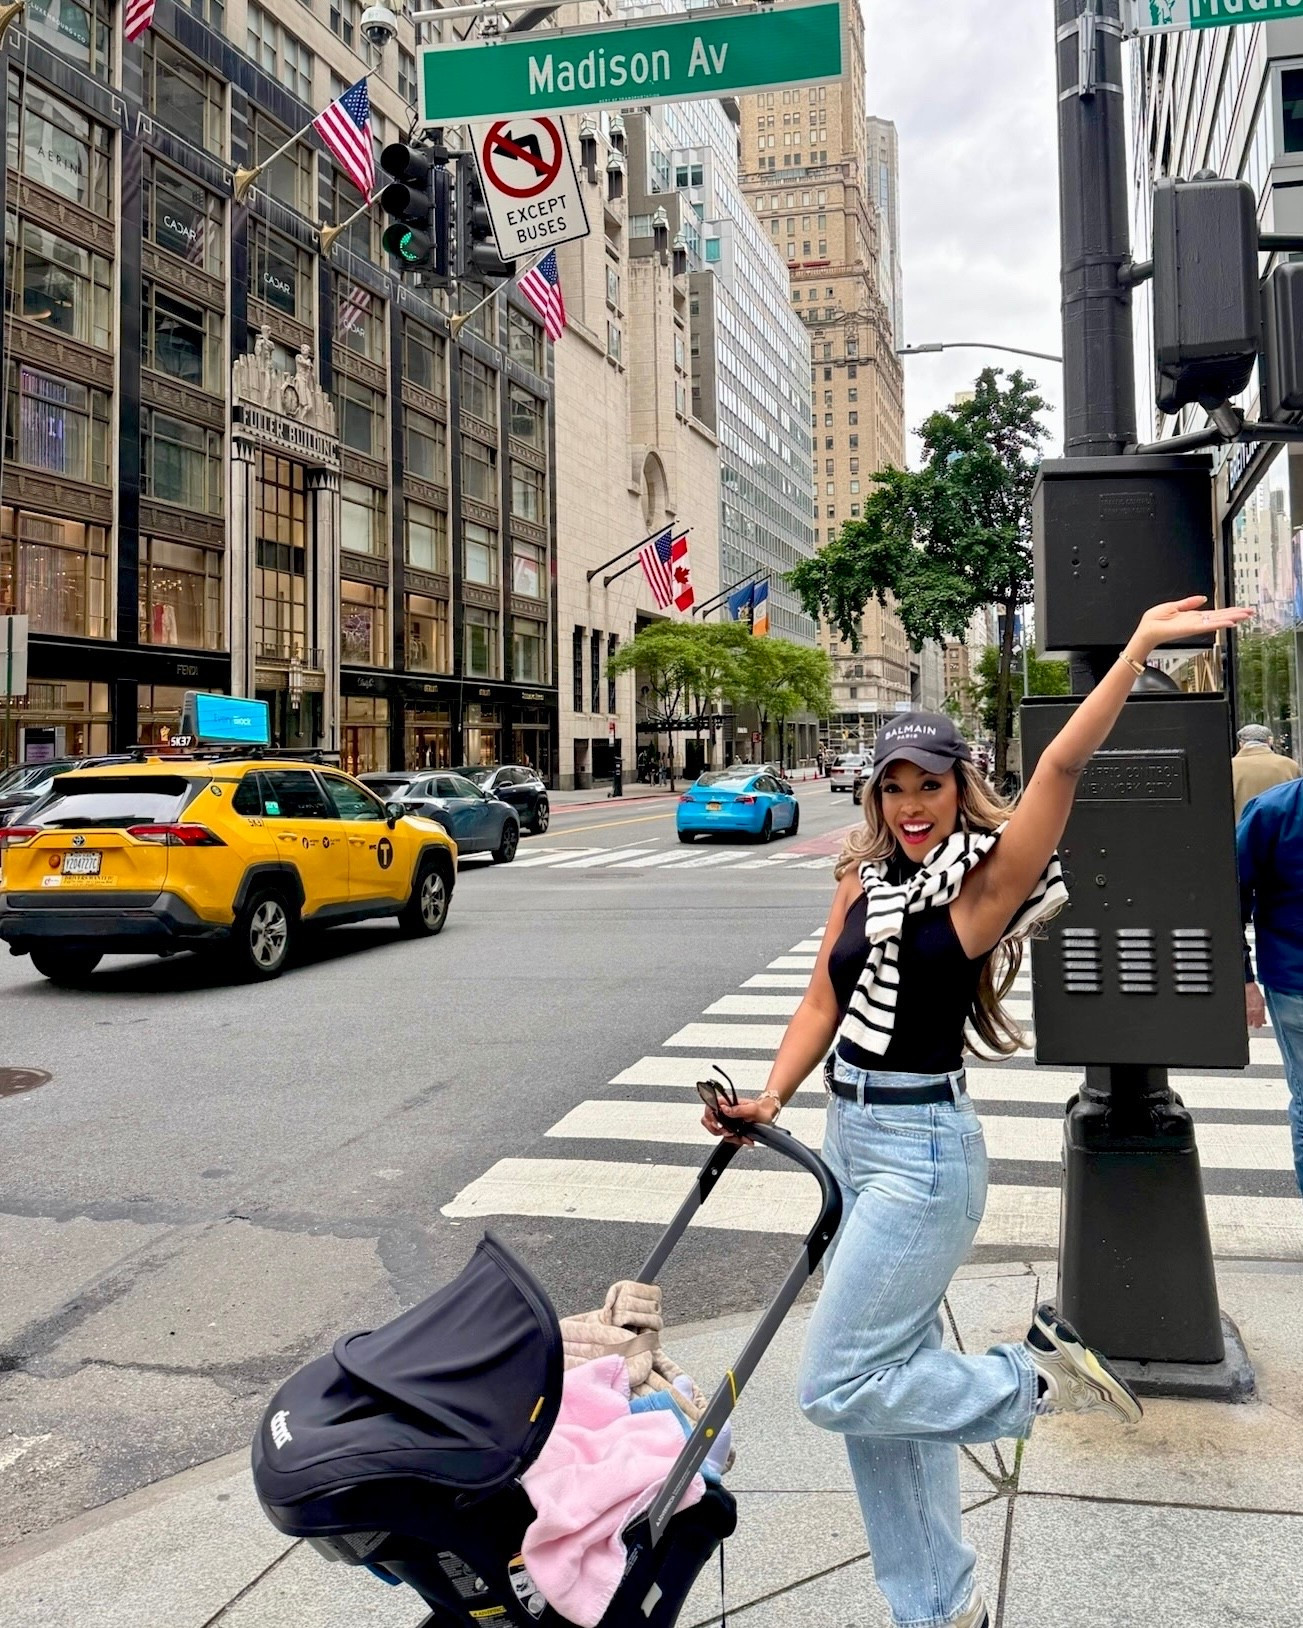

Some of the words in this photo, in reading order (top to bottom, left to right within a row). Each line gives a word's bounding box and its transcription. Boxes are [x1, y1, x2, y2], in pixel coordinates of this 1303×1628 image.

[528, 48, 670, 95] Madison
[687, 36, 729, 77] Av
[38, 146, 78, 175] AERIN
[506, 195, 566, 226] EXCEPT
[517, 216, 567, 244] BUSES
[243, 409, 285, 439] FULLER
[289, 426, 337, 461] BUILDING
[885, 725, 936, 740] BALMAIN
[1082, 766, 1120, 778] RAFFIC
[380, 843, 390, 866] T
